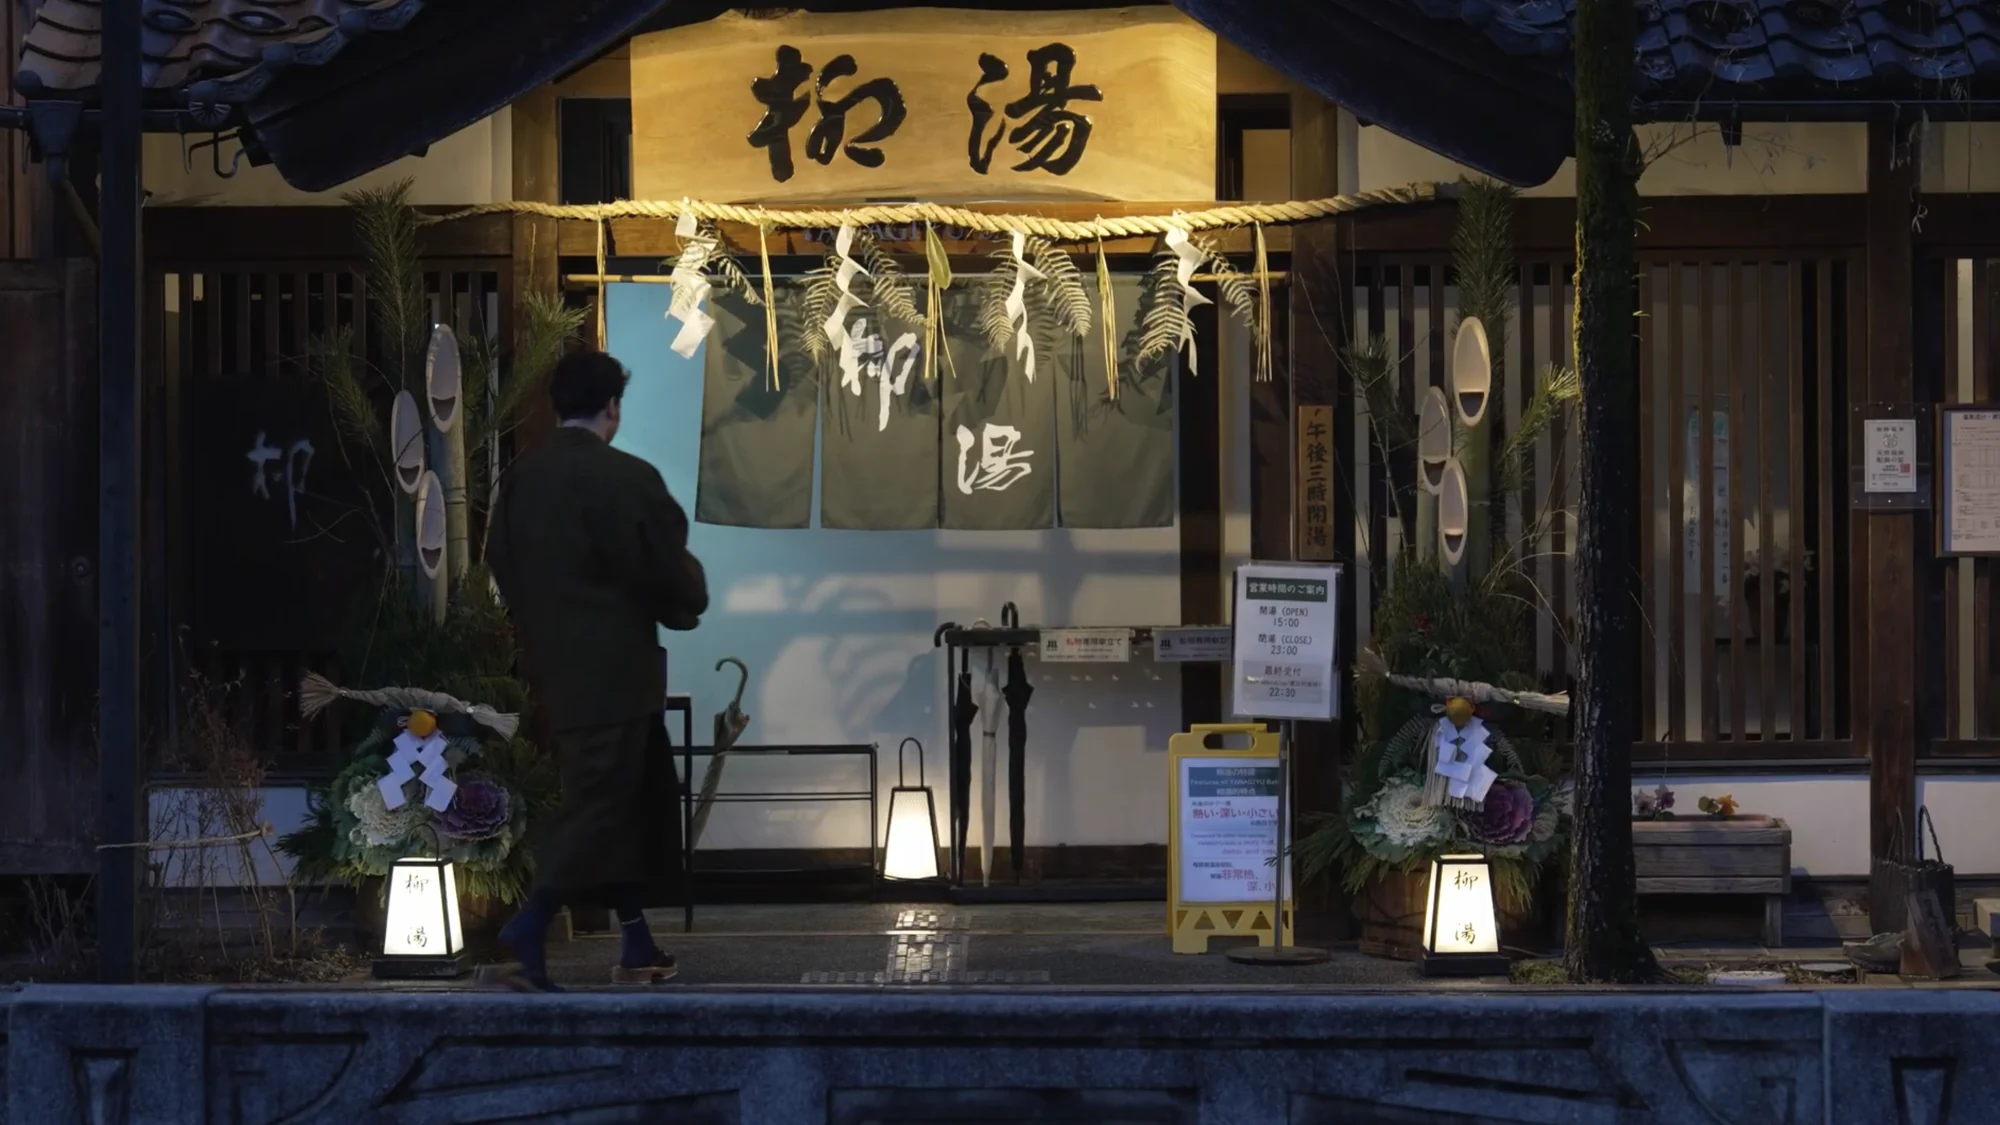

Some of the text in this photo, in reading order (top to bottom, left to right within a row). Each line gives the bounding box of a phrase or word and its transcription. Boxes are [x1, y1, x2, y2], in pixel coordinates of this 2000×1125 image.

[746, 42, 1103, 182] 柳湯
[1248, 582, 1325, 596] 営業時間のご案内
[1273, 617, 1300, 628] 15:00
[1270, 645, 1298, 656] 23:00
[1264, 666, 1302, 677] 最終受付
[1269, 688, 1296, 698] 22:30
